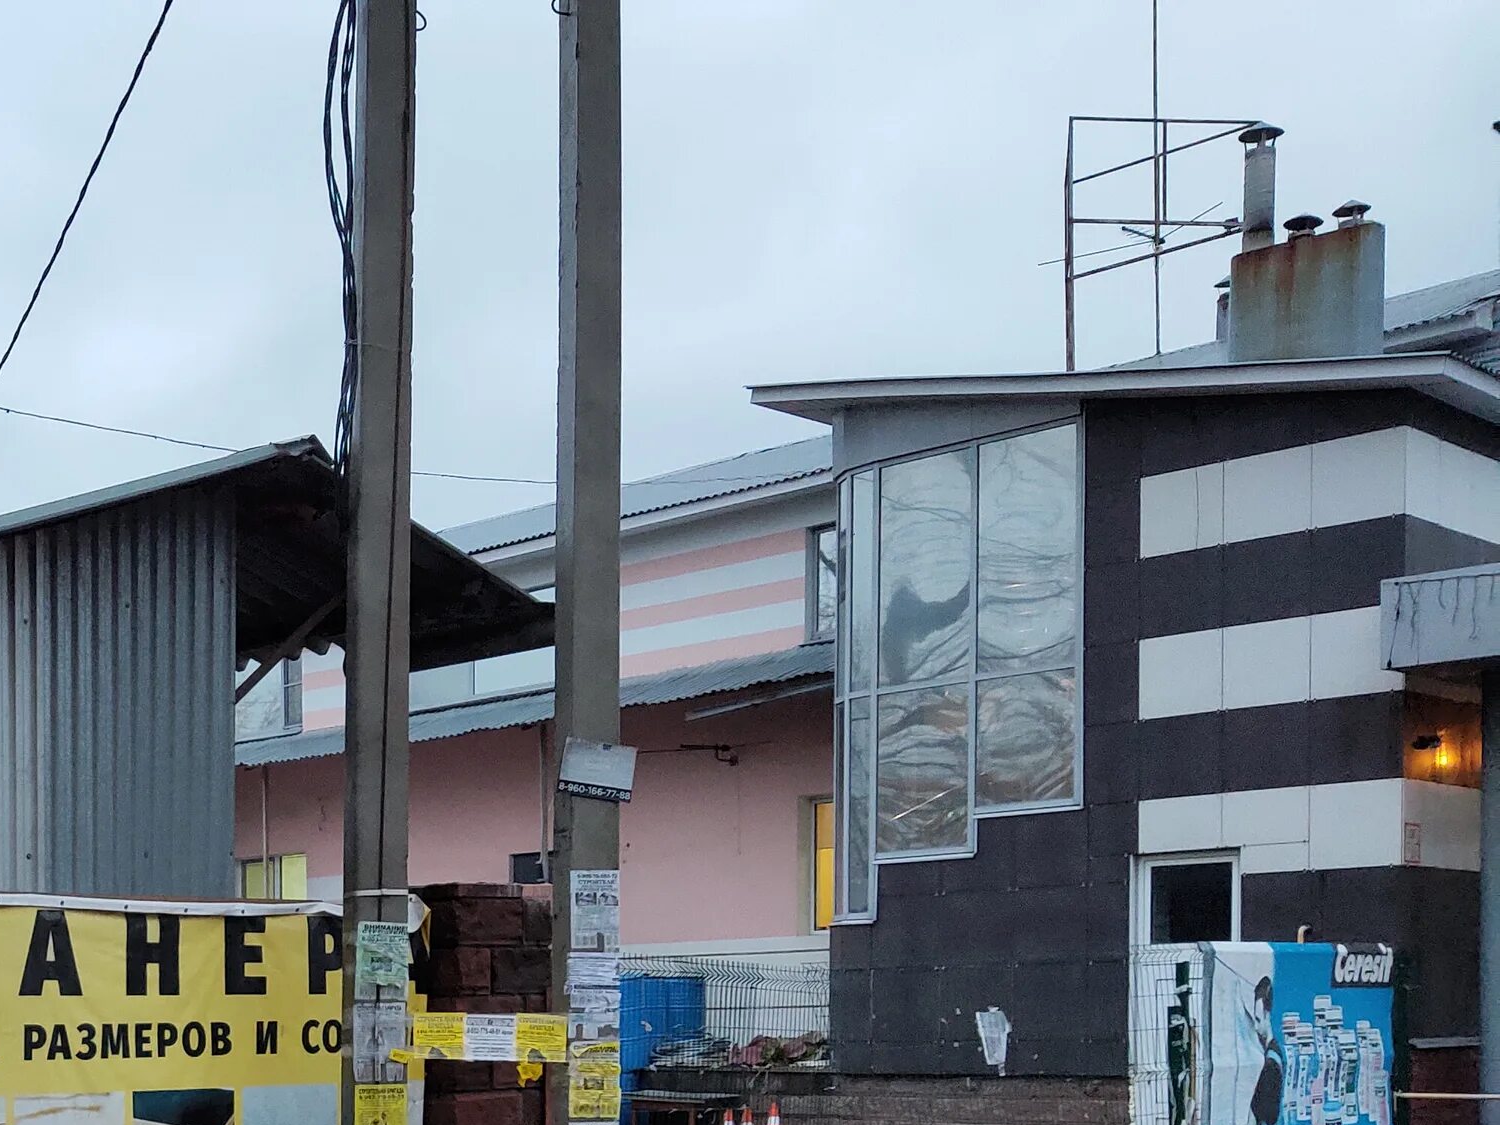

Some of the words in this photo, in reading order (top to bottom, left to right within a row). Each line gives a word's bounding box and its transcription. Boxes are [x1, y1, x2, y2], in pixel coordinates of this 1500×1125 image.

[1334, 943, 1393, 983] Ceresit
[23, 1020, 233, 1061] РАЗМЕРОВ
[256, 1020, 279, 1055] И
